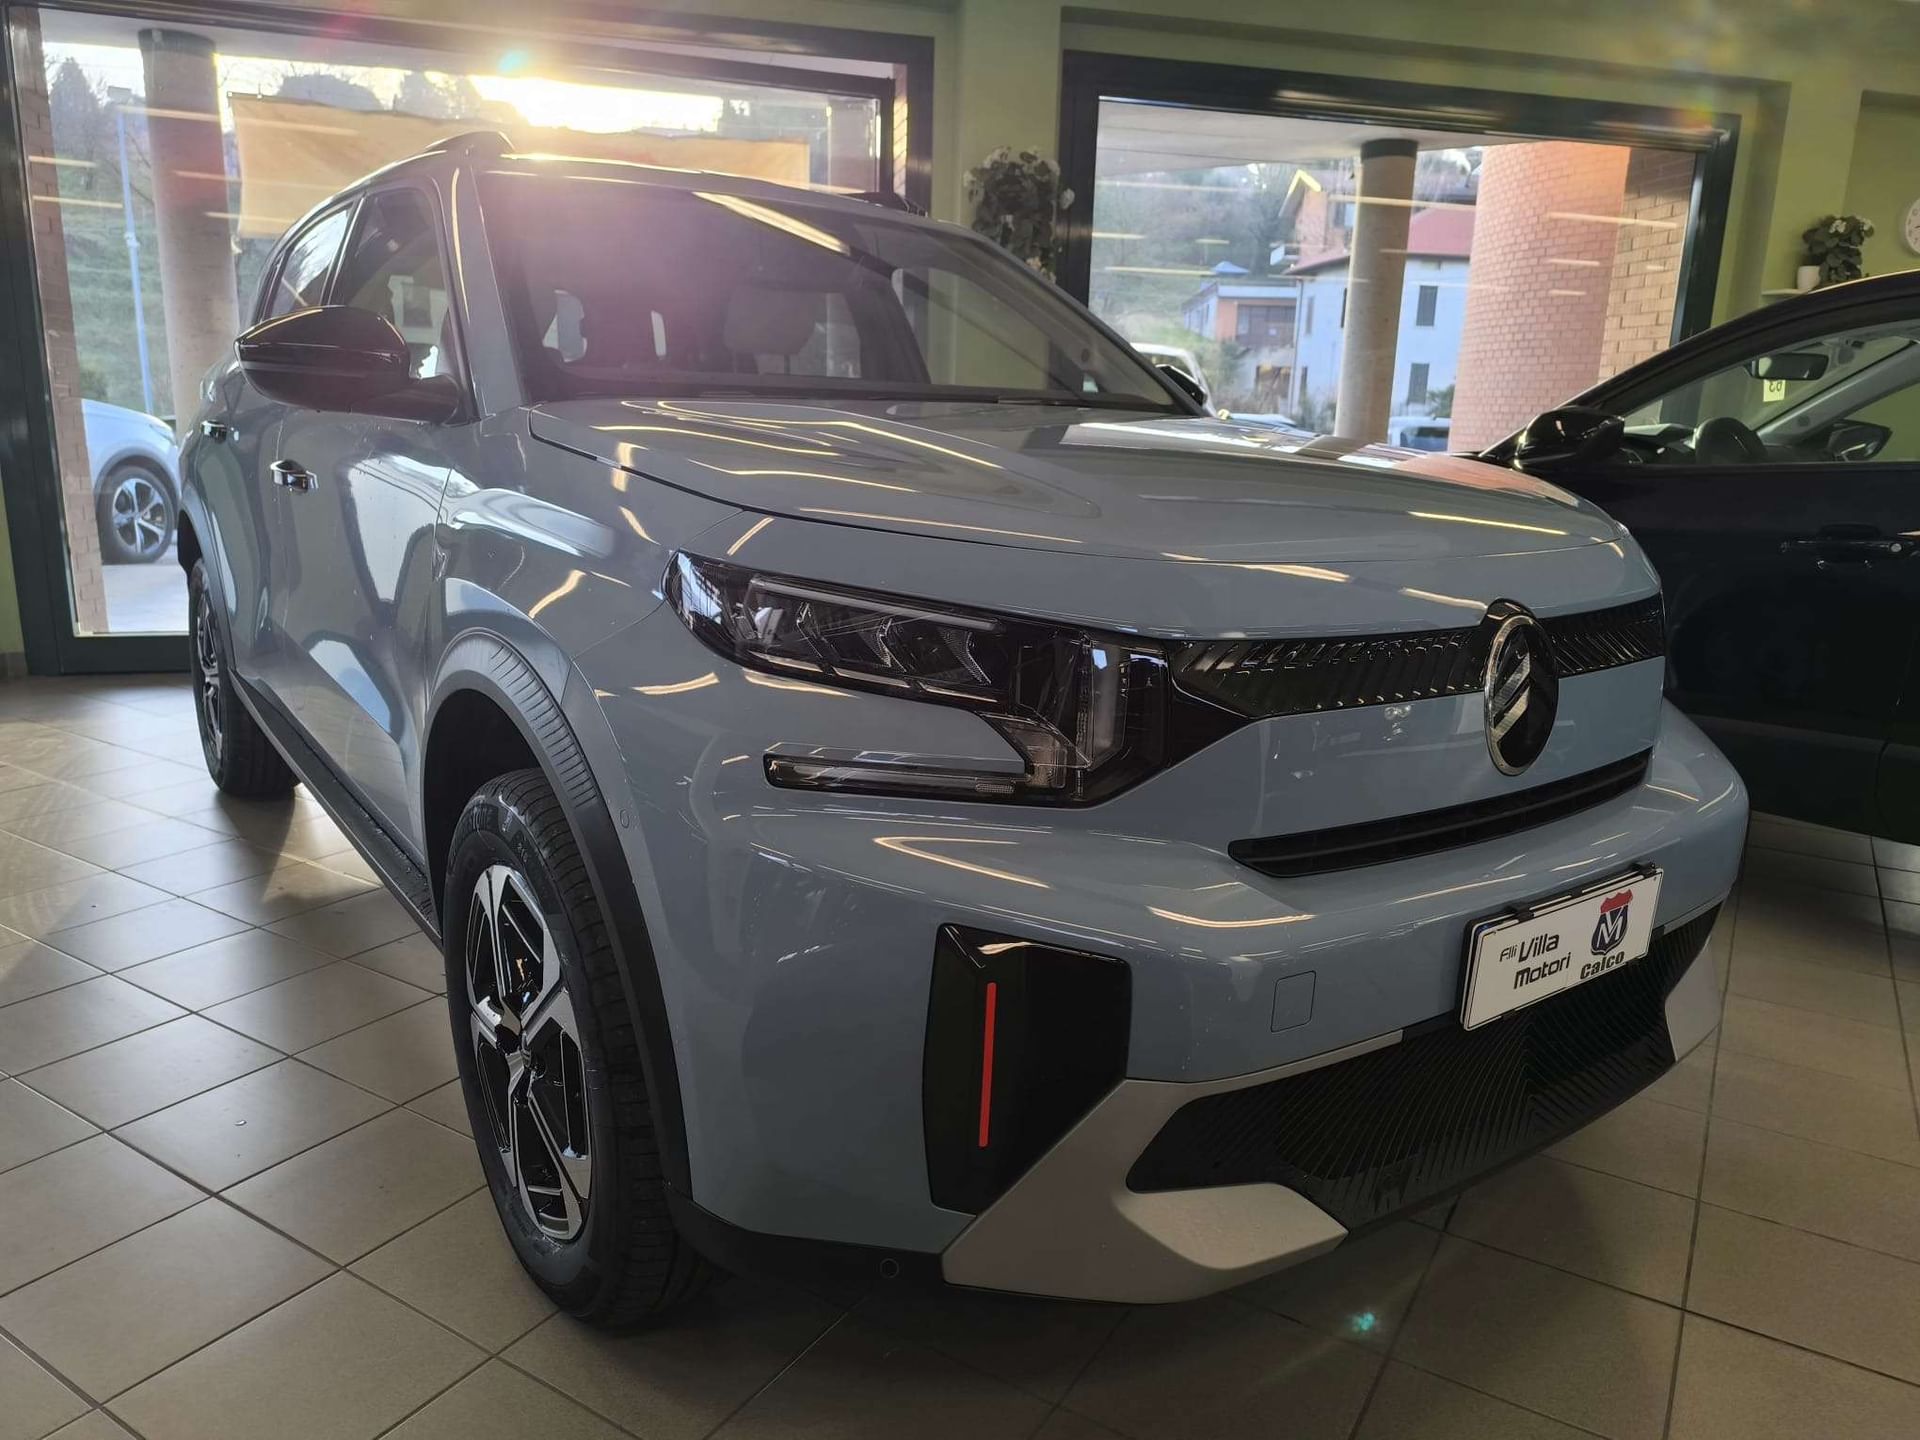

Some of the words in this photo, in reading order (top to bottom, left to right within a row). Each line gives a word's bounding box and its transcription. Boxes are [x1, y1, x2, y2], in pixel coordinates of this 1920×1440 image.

[1518, 933, 1560, 963] Villa
[1513, 951, 1571, 989] Motori
[1580, 951, 1625, 980] Calco
